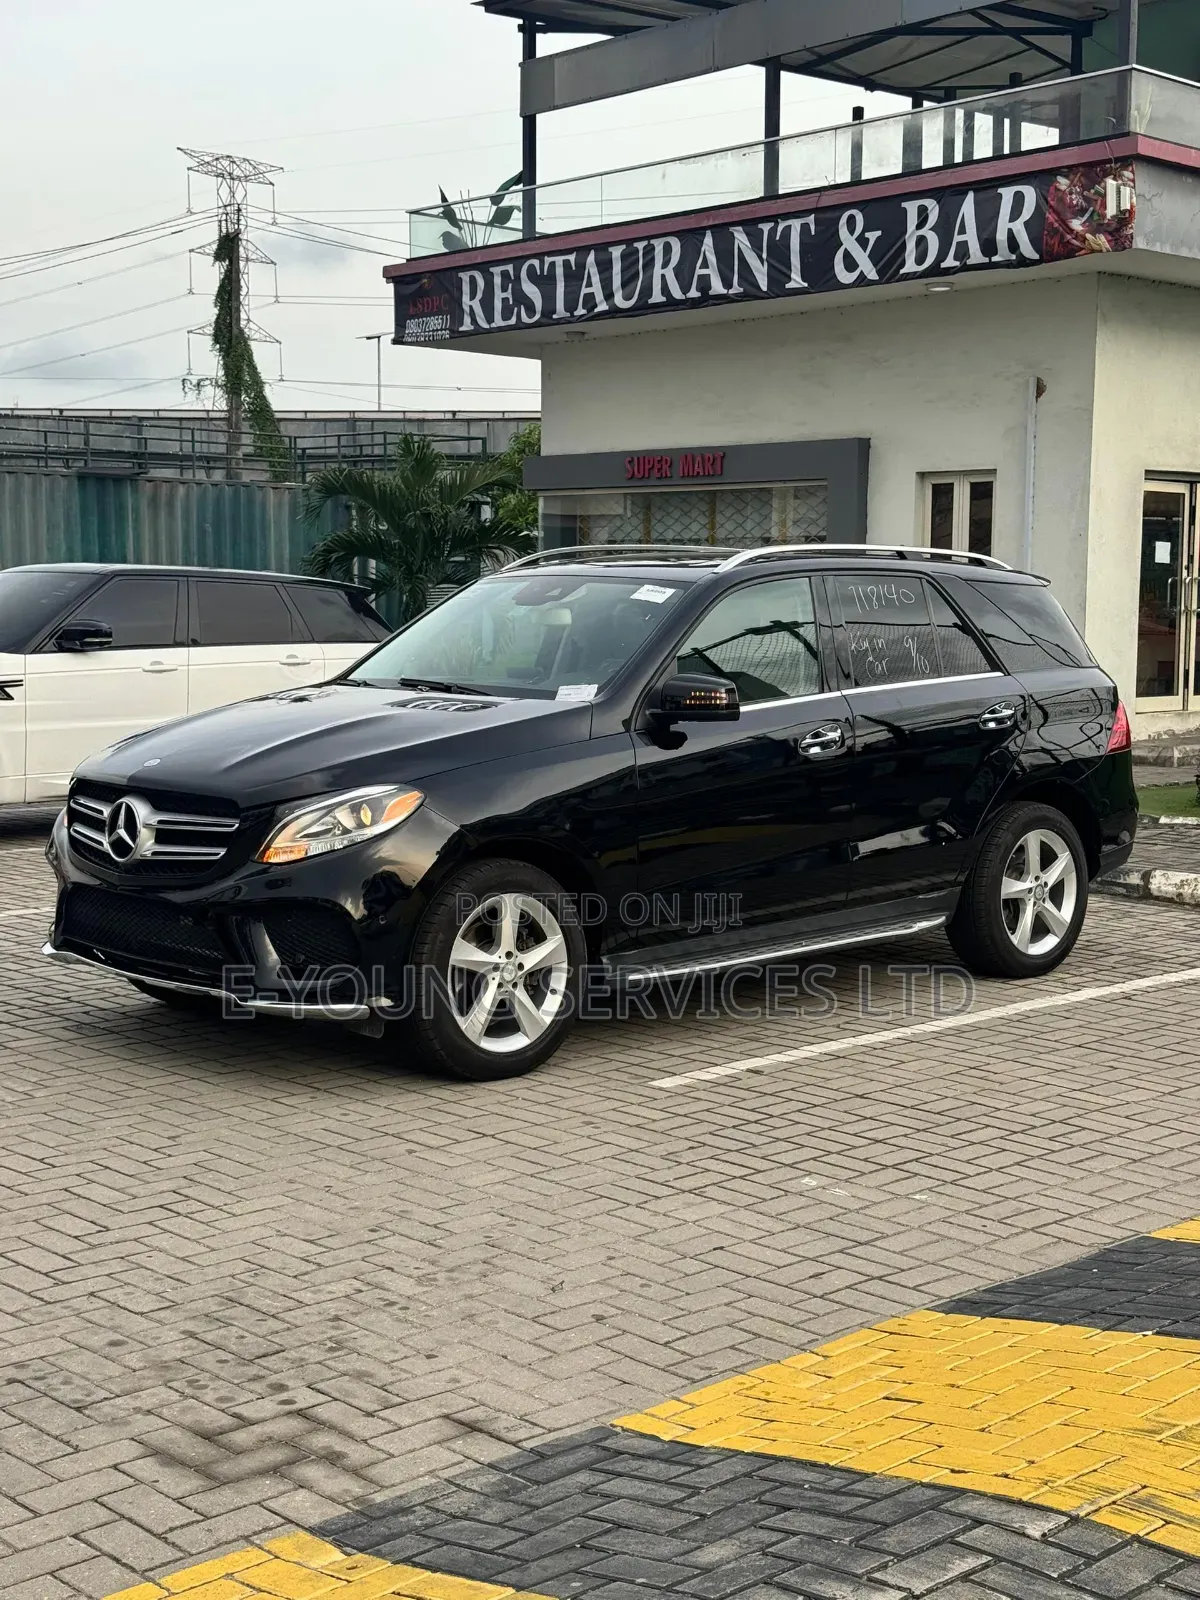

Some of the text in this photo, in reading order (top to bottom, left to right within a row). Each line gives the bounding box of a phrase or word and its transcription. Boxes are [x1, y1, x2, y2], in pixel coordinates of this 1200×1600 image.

[458, 184, 1040, 332] RESTAURANT & BAR
[624, 452, 724, 479] SUPER MART
